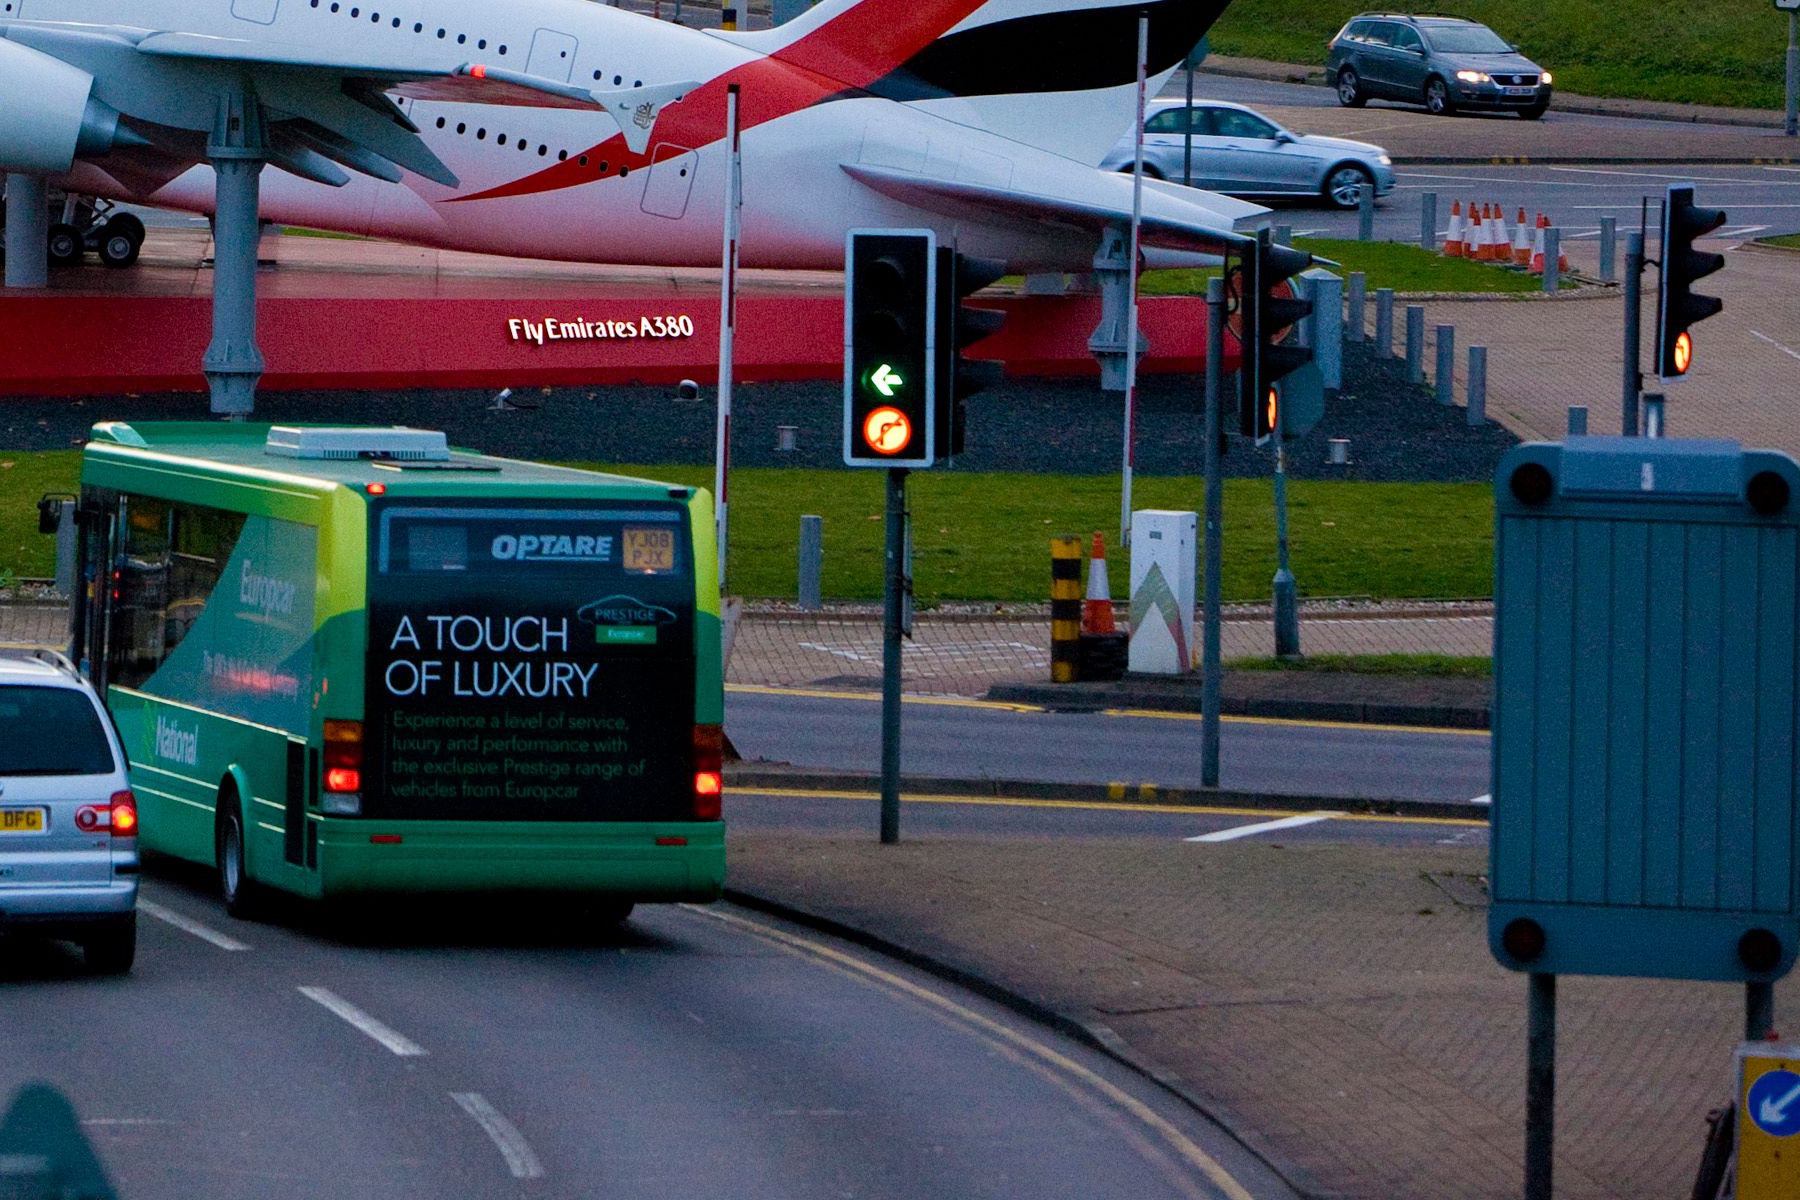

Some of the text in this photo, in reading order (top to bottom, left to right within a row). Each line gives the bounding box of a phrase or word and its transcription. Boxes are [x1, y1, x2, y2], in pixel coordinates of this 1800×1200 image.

[508, 315, 695, 346] Fly Emirates A380
[491, 534, 613, 561] OPTARE
[627, 531, 670, 548] YJ08
[633, 551, 663, 565] PJX
[595, 609, 656, 621] PRESTIGE
[390, 615, 568, 652] A TOUCH
[385, 660, 600, 698] OF LUXURY
[393, 711, 629, 731] Experience a level of service,
[155, 715, 199, 766] National
[392, 735, 628, 755] luxury and performance with
[391, 757, 647, 780] the exclusive Prestige range of
[391, 779, 580, 800] vehicles from Europcar
